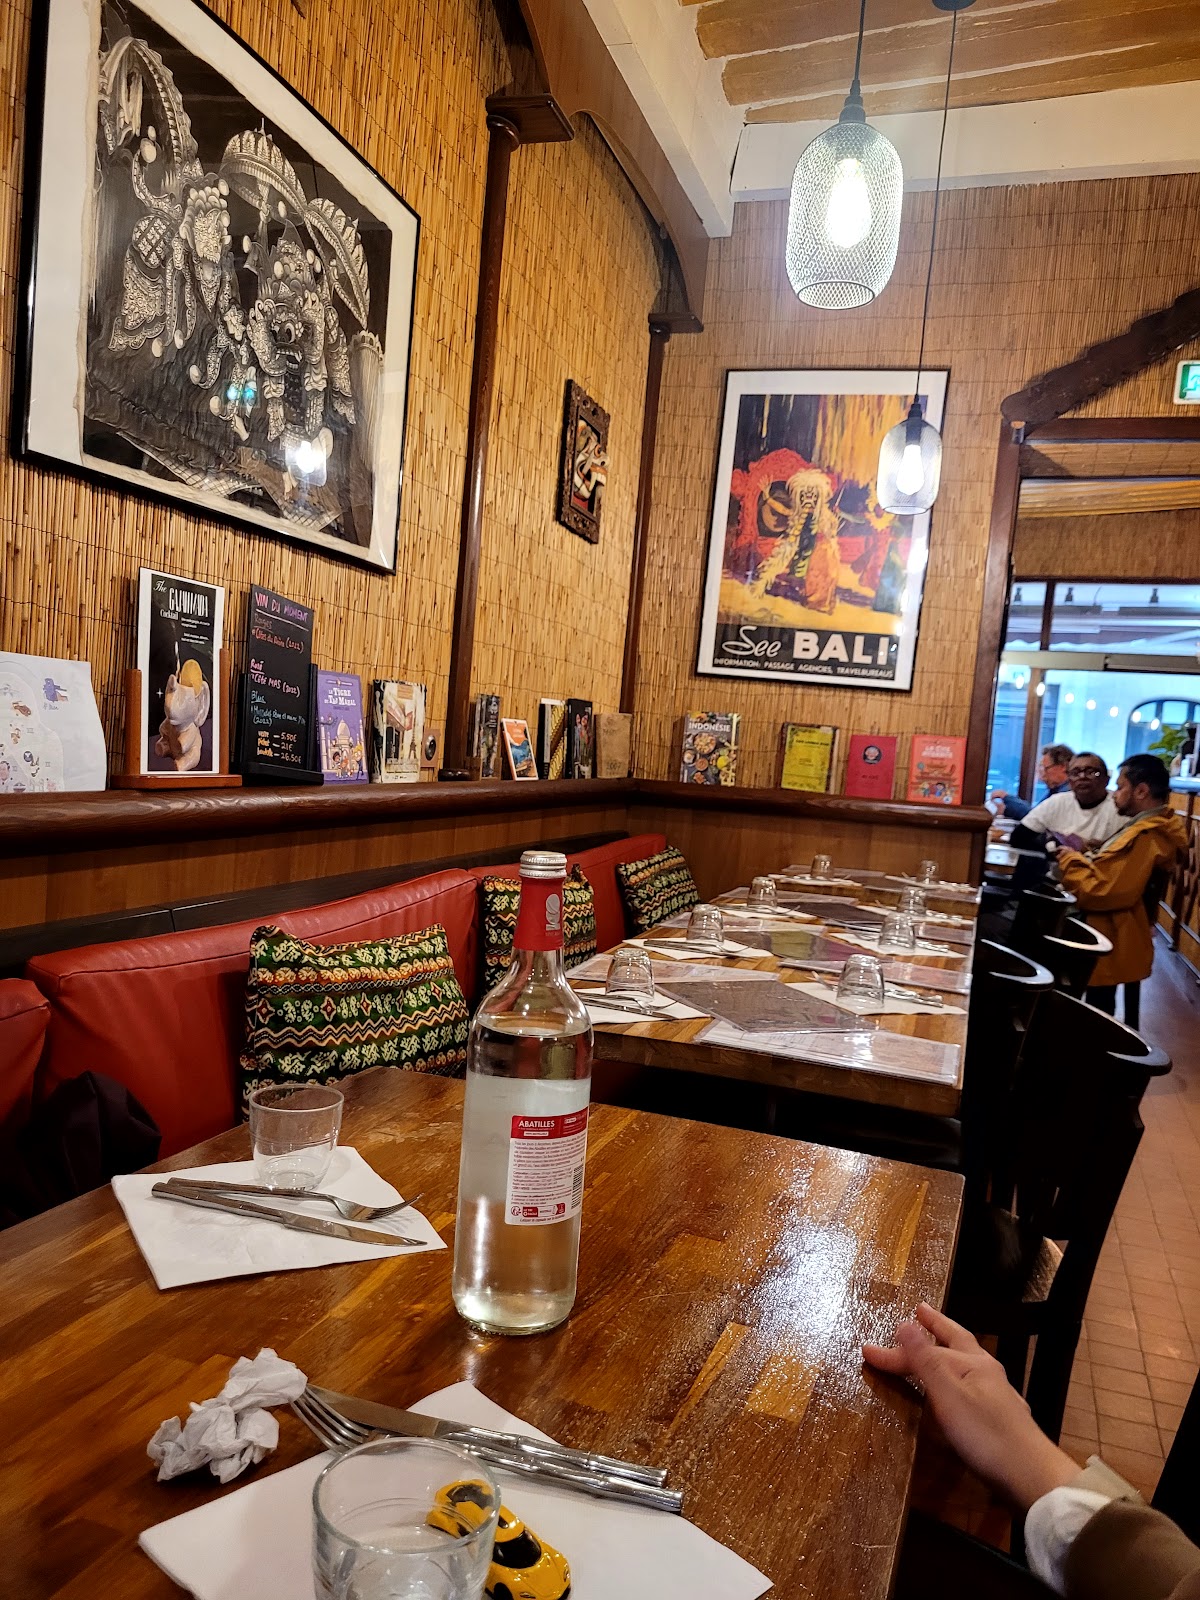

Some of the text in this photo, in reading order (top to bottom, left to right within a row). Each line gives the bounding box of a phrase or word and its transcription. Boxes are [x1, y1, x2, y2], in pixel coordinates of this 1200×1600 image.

[153, 580, 167, 592] The
[255, 592, 308, 622] VIN DU MOMENT
[160, 609, 178, 620] Cocktail
[722, 626, 889, 664] See BALI
[764, 662, 794, 671] PASSAGE
[689, 722, 731, 732] INDONÉSIE
[518, 1120, 555, 1128] ABATILLES
